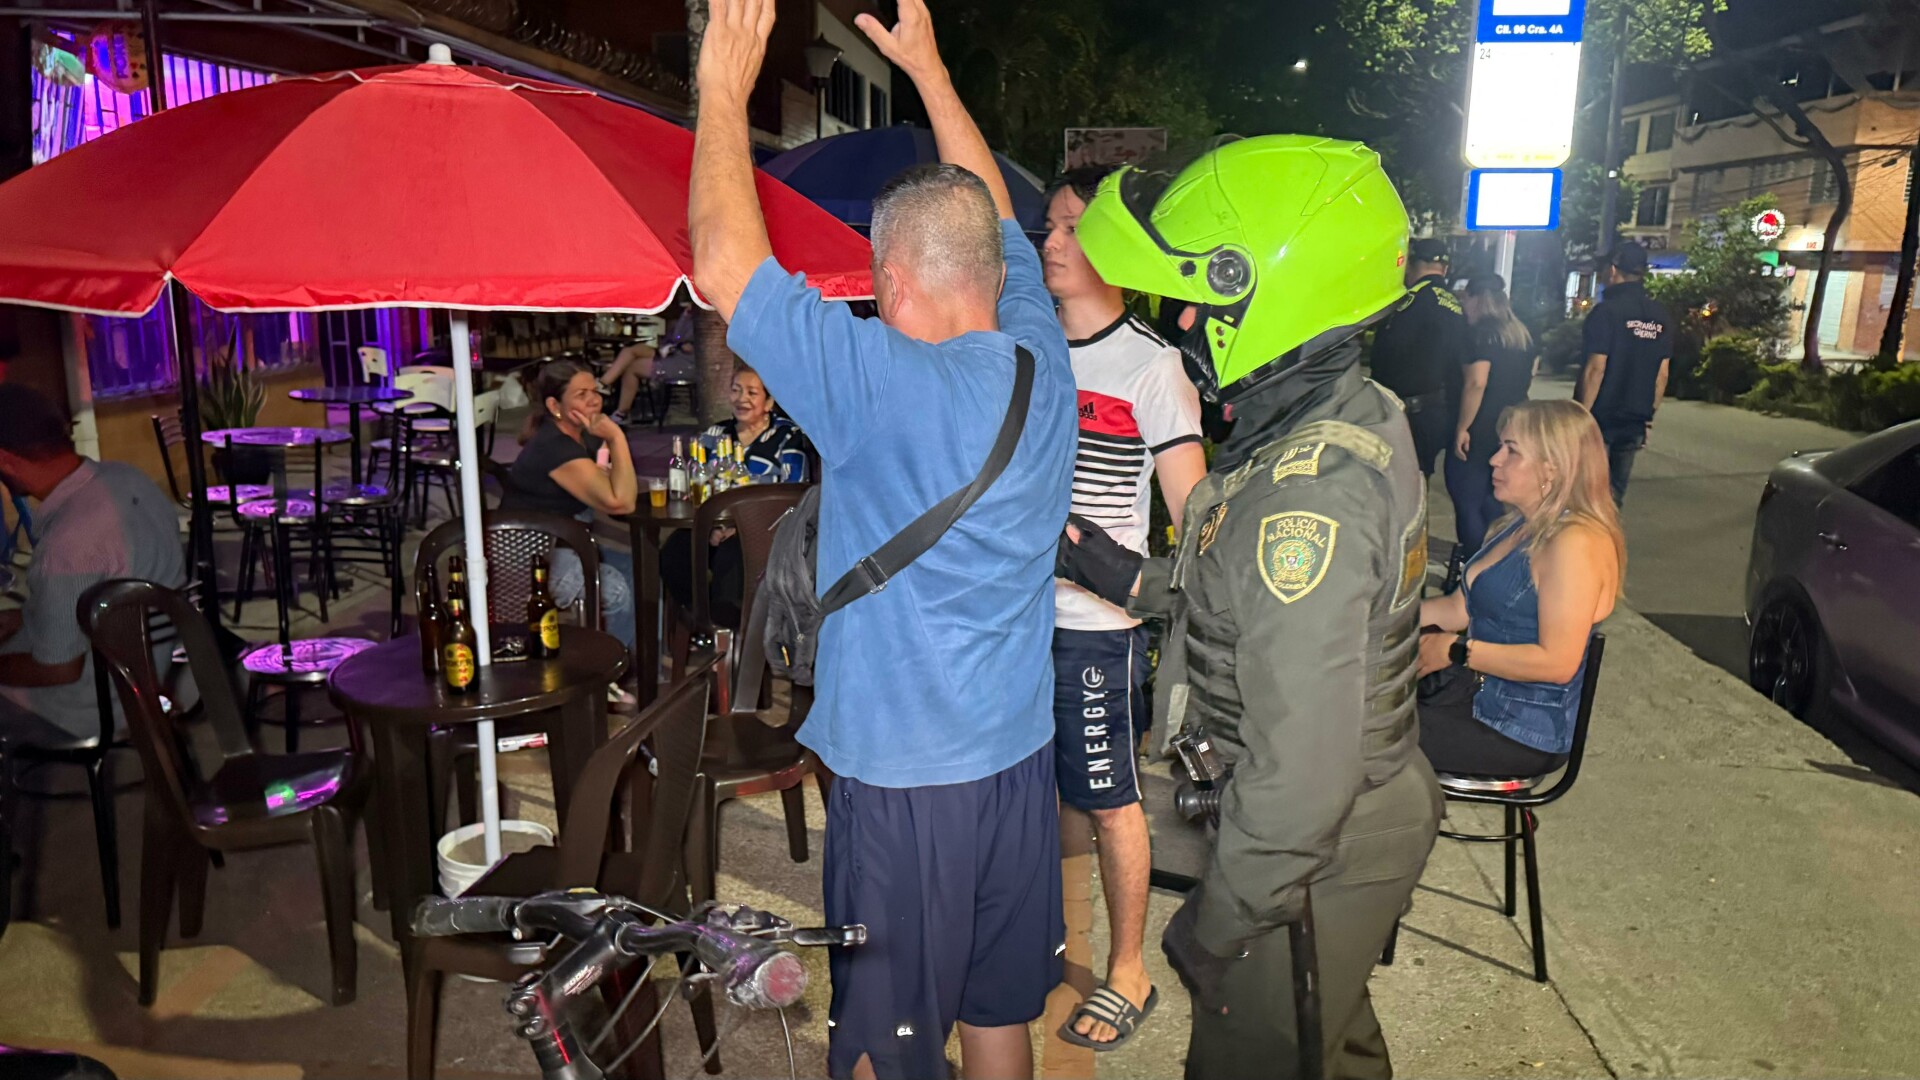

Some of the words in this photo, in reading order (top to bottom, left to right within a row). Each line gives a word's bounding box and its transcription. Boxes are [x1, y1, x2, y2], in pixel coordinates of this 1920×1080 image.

[1549, 24, 1564, 34] 4A
[1480, 48, 1491, 60] 24
[1277, 518, 1318, 532] POLICÍA
[1267, 528, 1327, 548] NACIONAL
[1083, 690, 1115, 790] ENERGY
